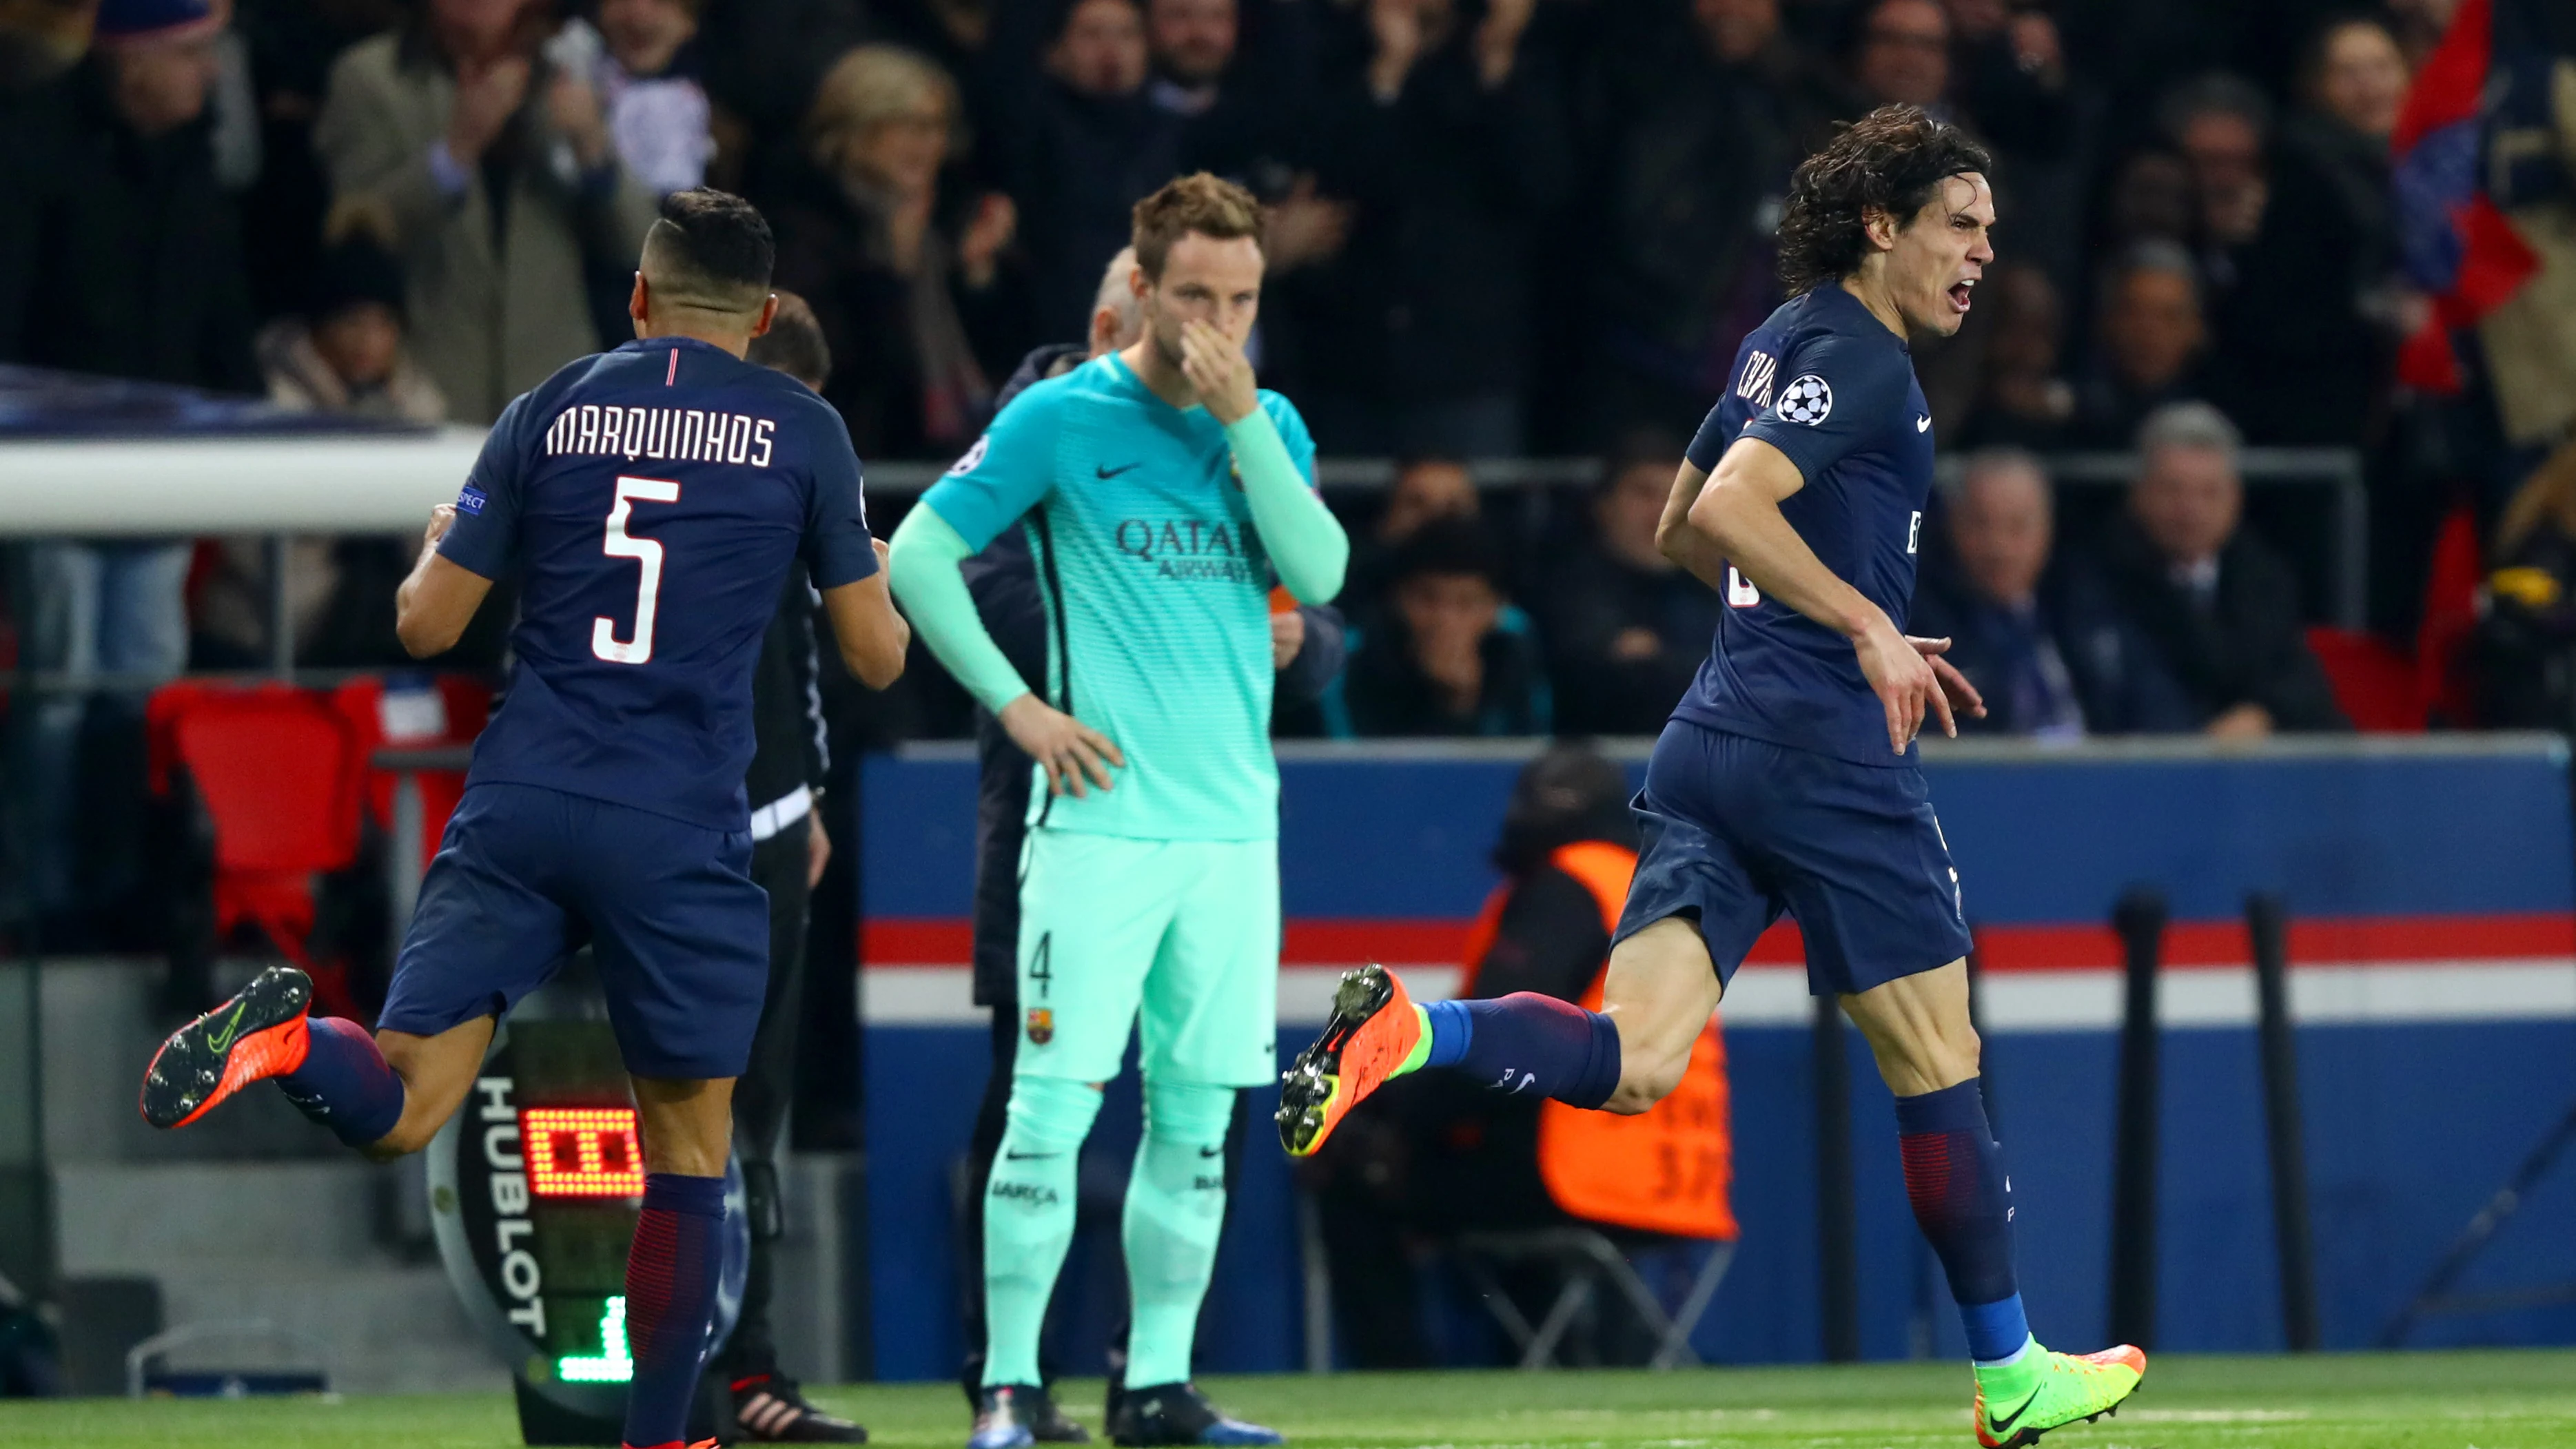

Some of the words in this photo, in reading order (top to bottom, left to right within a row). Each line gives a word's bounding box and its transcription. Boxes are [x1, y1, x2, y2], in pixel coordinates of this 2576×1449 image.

[546, 404, 775, 467] MARQUINHOS
[591, 475, 681, 665] 5
[1029, 930, 1052, 998] 4
[478, 1076, 546, 1337] HUBLOT
